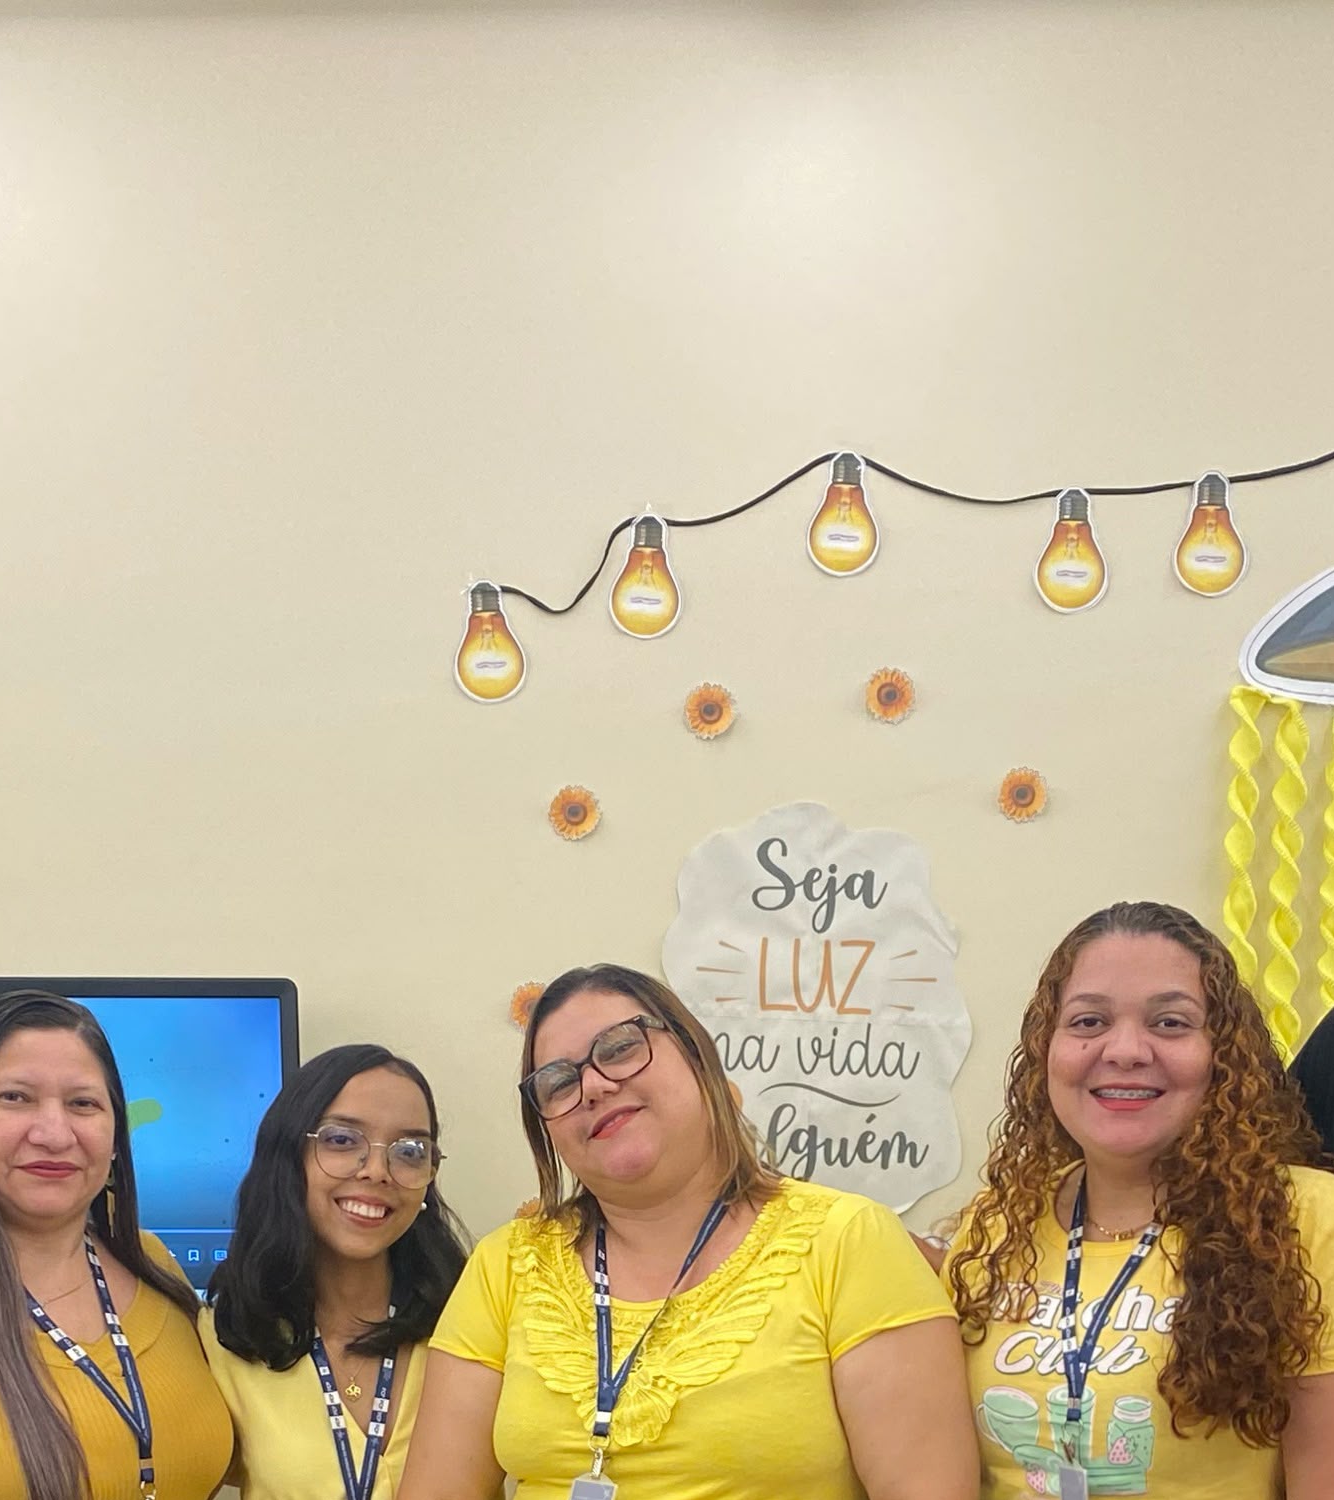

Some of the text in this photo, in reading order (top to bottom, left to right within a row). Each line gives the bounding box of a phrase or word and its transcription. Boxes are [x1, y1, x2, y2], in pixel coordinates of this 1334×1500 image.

[751, 837, 888, 934] Seja
[759, 937, 875, 1014] LUZ
[797, 1023, 920, 1080] vida
[759, 1103, 930, 1180] lguém
